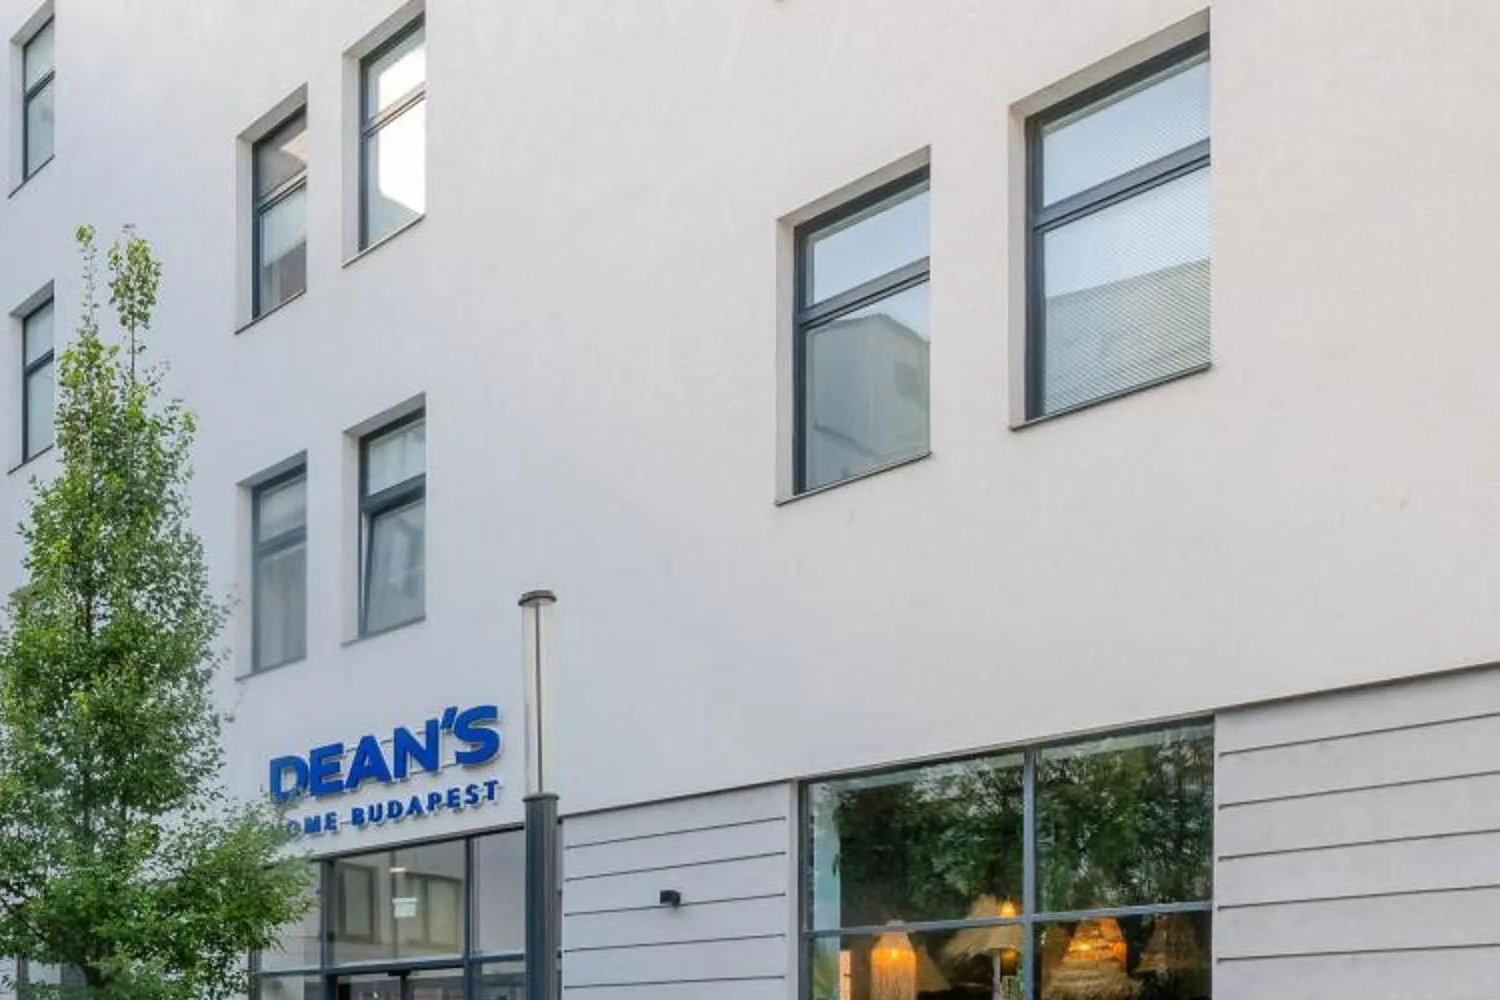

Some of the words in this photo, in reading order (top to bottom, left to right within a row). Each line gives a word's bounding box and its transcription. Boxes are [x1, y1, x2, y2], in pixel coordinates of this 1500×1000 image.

[269, 704, 500, 803] DEAN'S
[284, 811, 338, 838] OME
[351, 779, 499, 827] BUDAPEST
